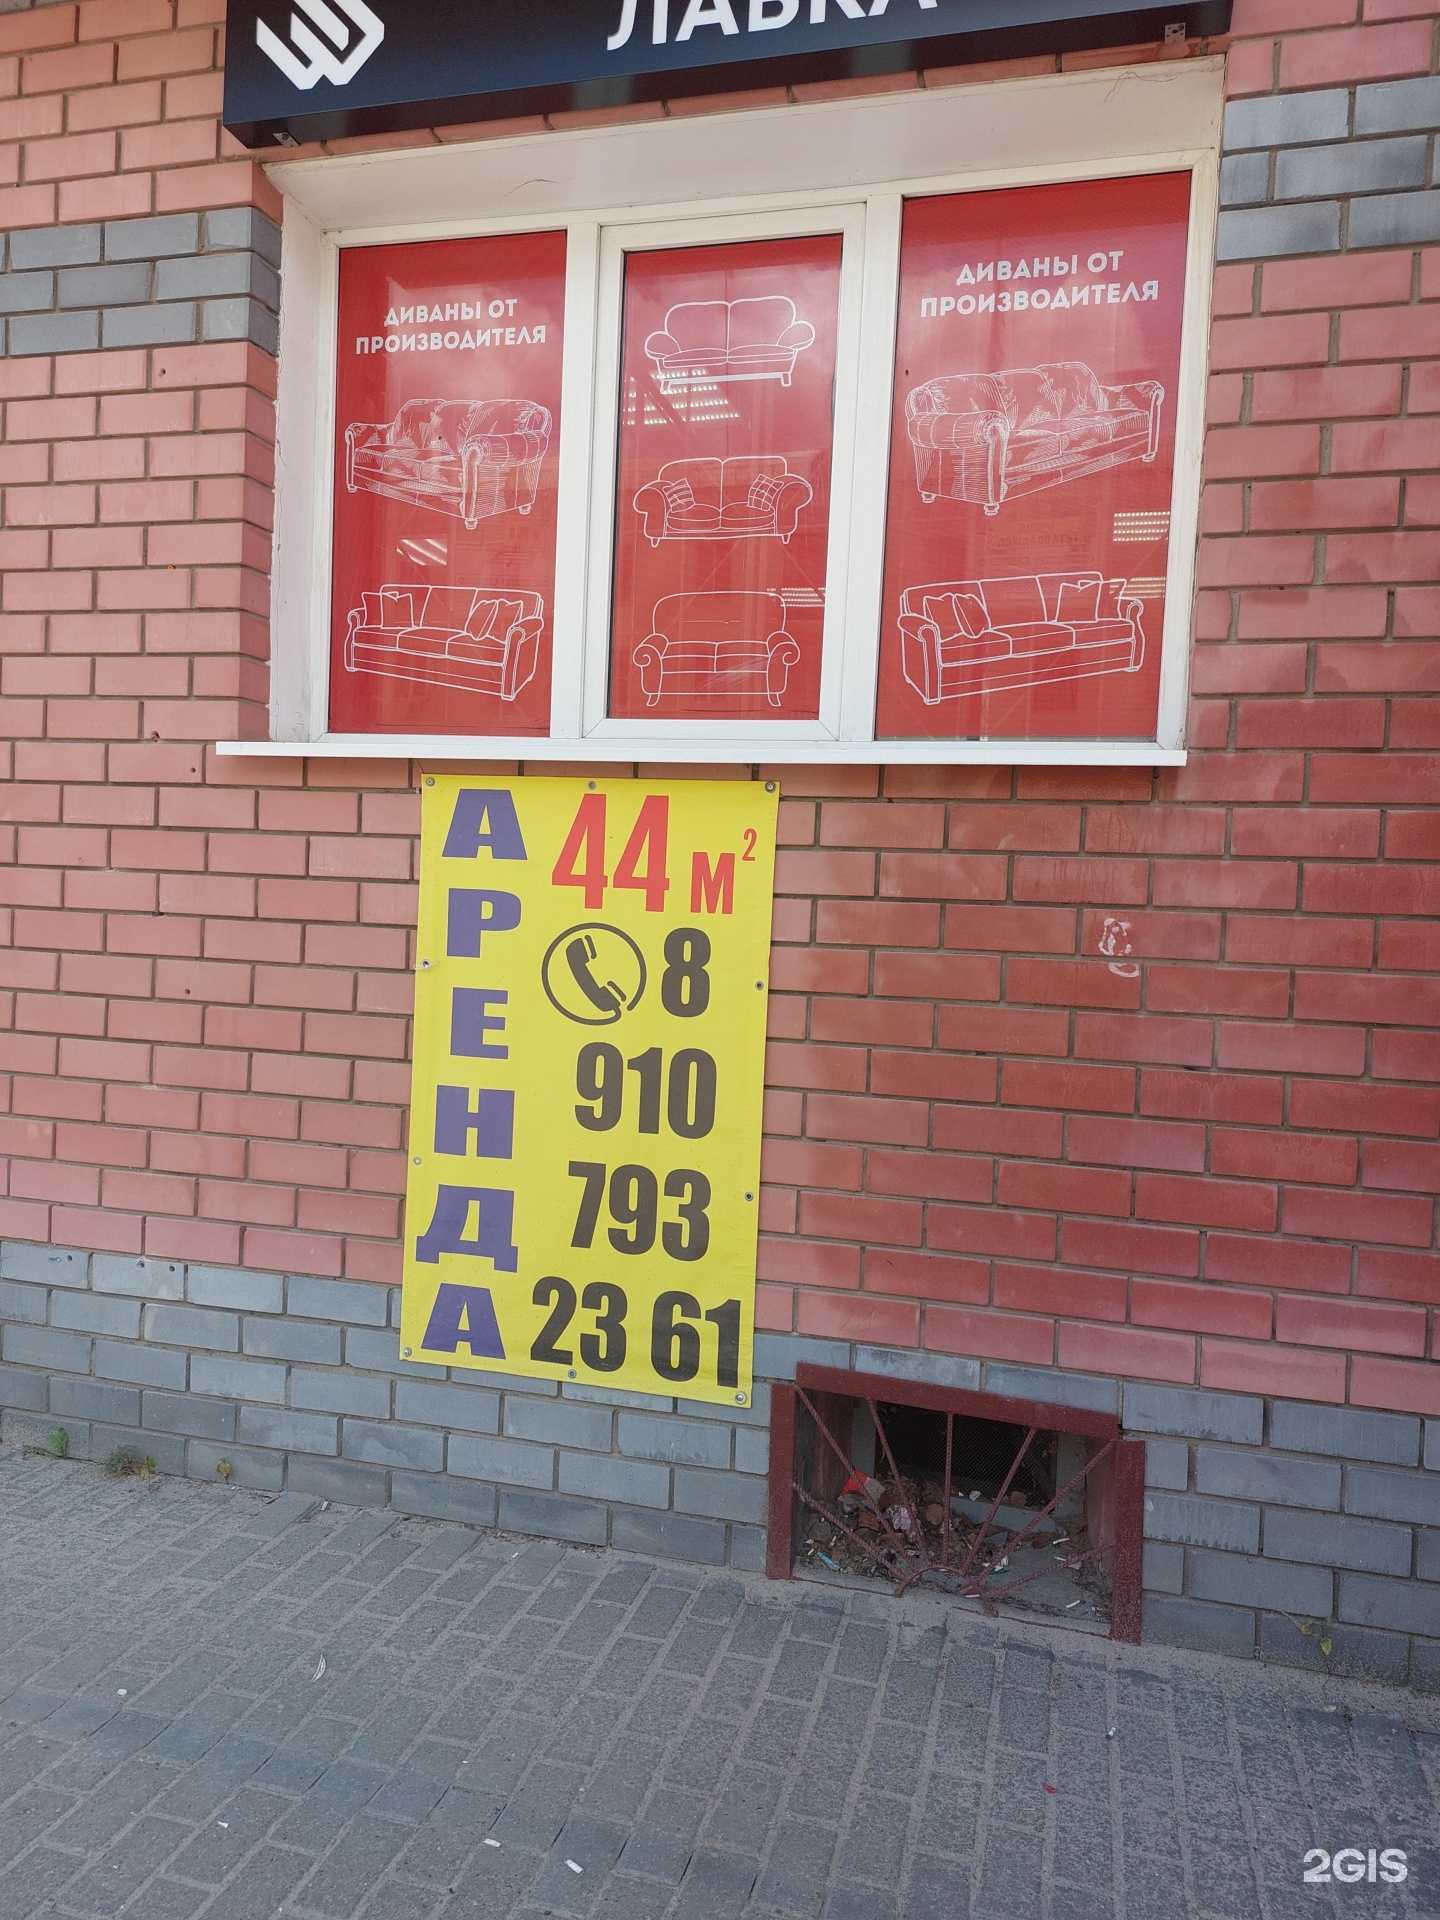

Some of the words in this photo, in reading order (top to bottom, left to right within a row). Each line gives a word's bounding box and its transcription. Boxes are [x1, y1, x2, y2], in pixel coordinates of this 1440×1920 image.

[607, 0, 938, 51] ЛАВ
[384, 301, 481, 327] ДИВАНЫ
[487, 298, 518, 320] ОТ
[920, 280, 1159, 318] ПРОИЗВОДИТЕЛЯ
[956, 254, 1078, 286] ДИВАНЫ
[1087, 251, 1124, 274] ОТ
[356, 325, 547, 354] ПРОИЗВОДИТЕЛЯ
[551, 793, 670, 913] 44
[660, 927, 712, 1018] 8
[415, 788, 528, 1361] АРЕНДА
[574, 1041, 718, 1140] 910
[567, 1160, 712, 1262] 793
[530, 1275, 628, 1373] 23
[650, 1290, 742, 1389] 61
